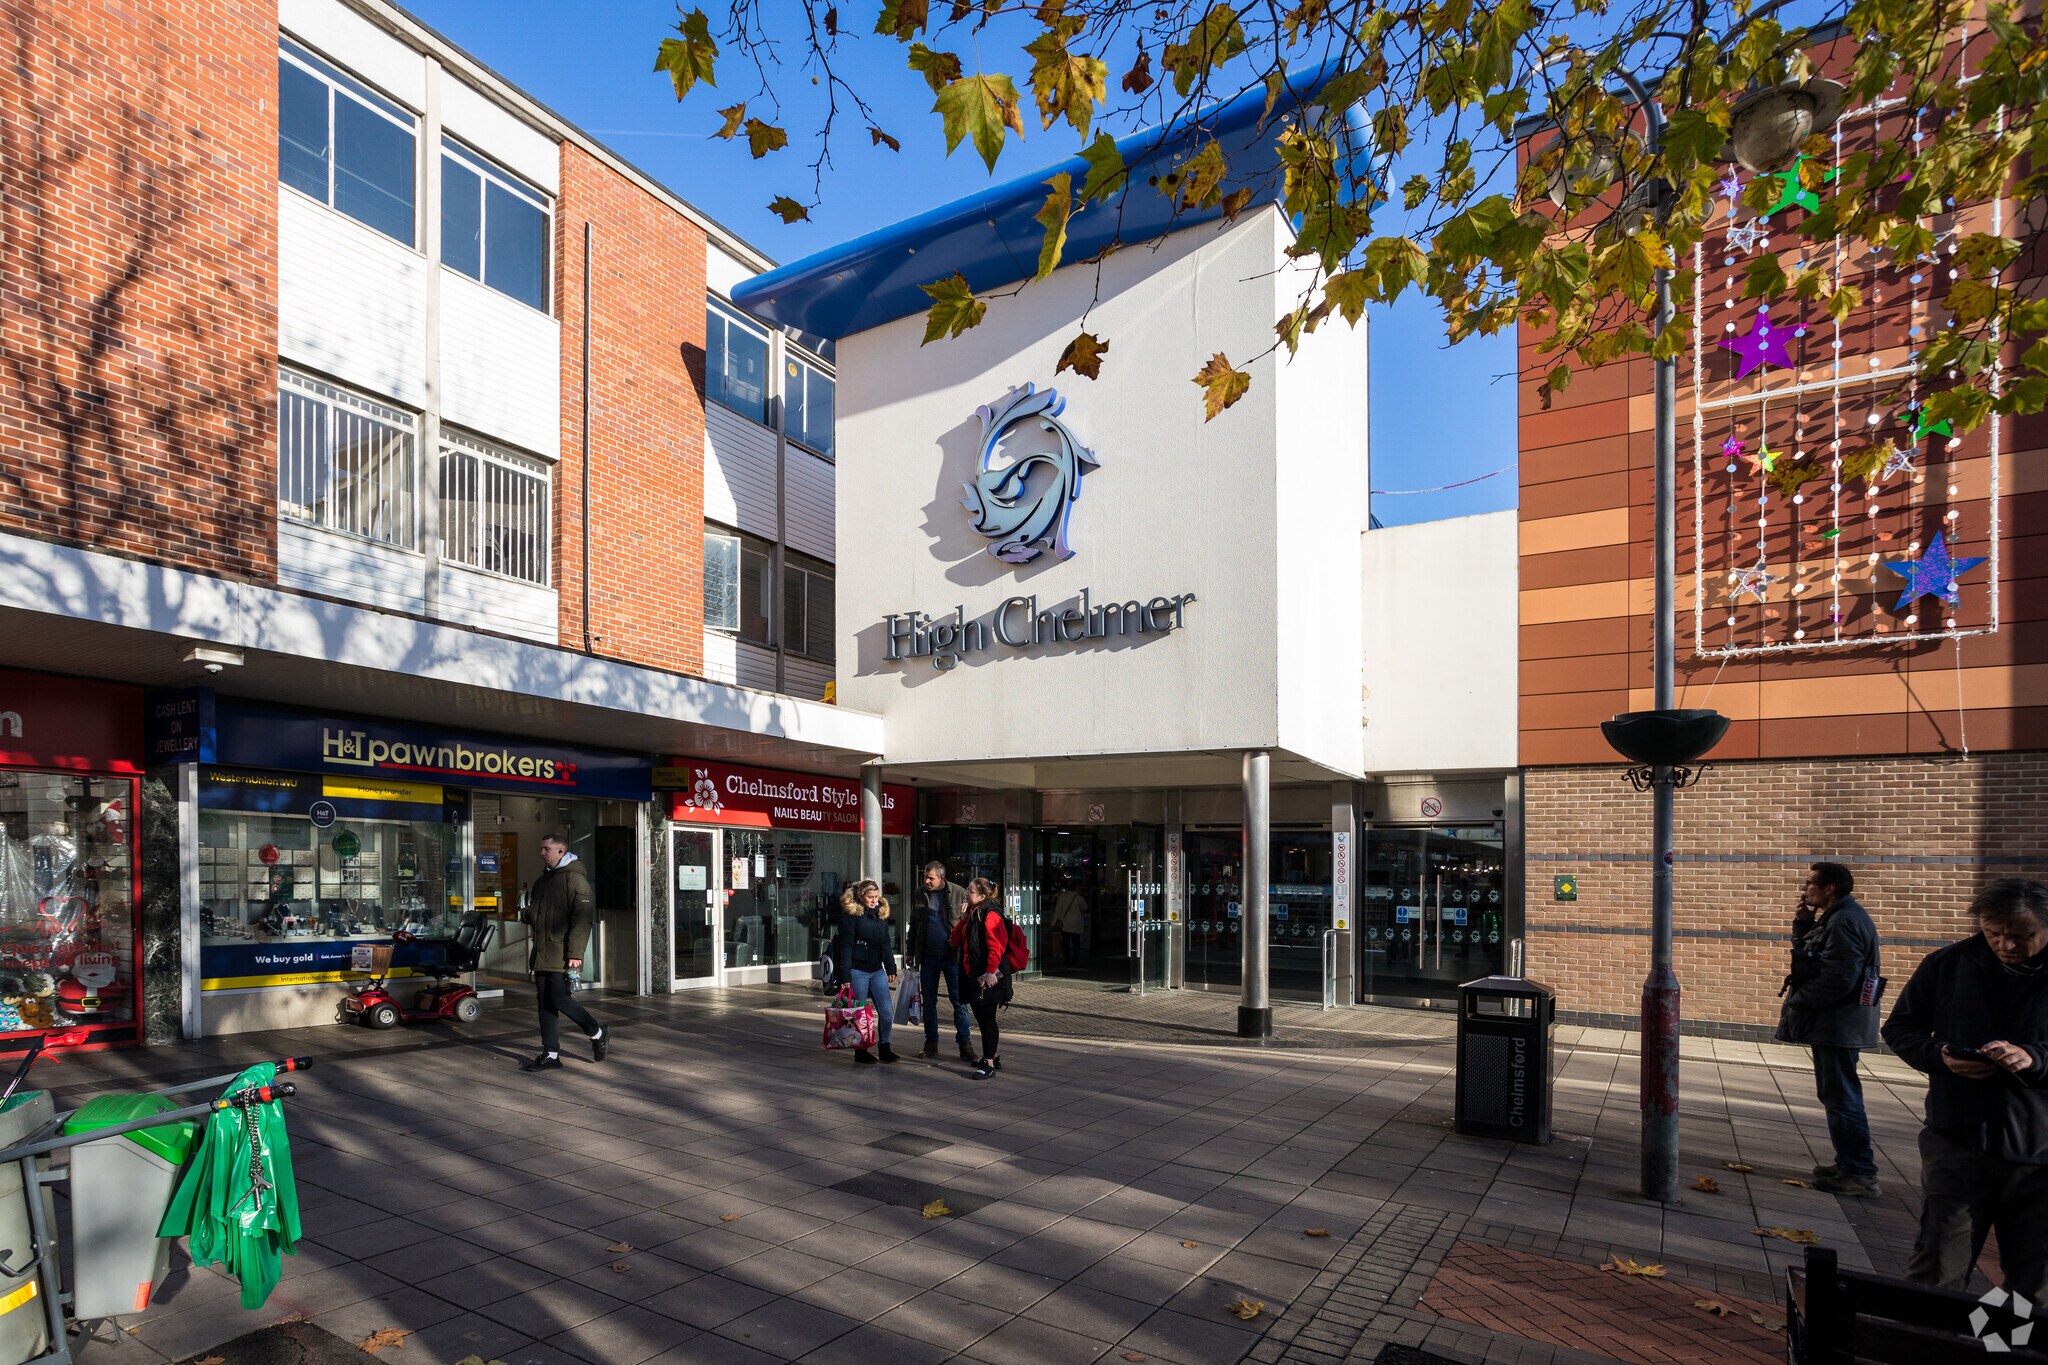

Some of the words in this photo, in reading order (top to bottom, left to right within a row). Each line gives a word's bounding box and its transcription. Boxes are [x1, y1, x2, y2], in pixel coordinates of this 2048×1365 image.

[882, 604, 984, 671] High
[993, 587, 1198, 647] Chelmer
[156, 703, 176, 718] CASH
[177, 700, 197, 715] LENT
[171, 720, 182, 734] ON
[156, 736, 199, 753] JEWELLERY
[358, 785, 383, 795] Money
[384, 787, 413, 796] transfer
[725, 775, 819, 802] Chelmsford
[822, 786, 858, 808] Style
[774, 806, 799, 819] NAILS
[800, 809, 832, 821] BEAUTY
[833, 812, 858, 823] SALON
[2, 942, 41, 956] Give
[80, 953, 121, 967] living
[255, 955, 271, 964] We
[273, 954, 291, 965] buy
[293, 953, 314, 964] gold
[280, 974, 321, 982] International
[321, 974, 343, 982] money
[1509, 1037, 1526, 1128] Chelmsford
